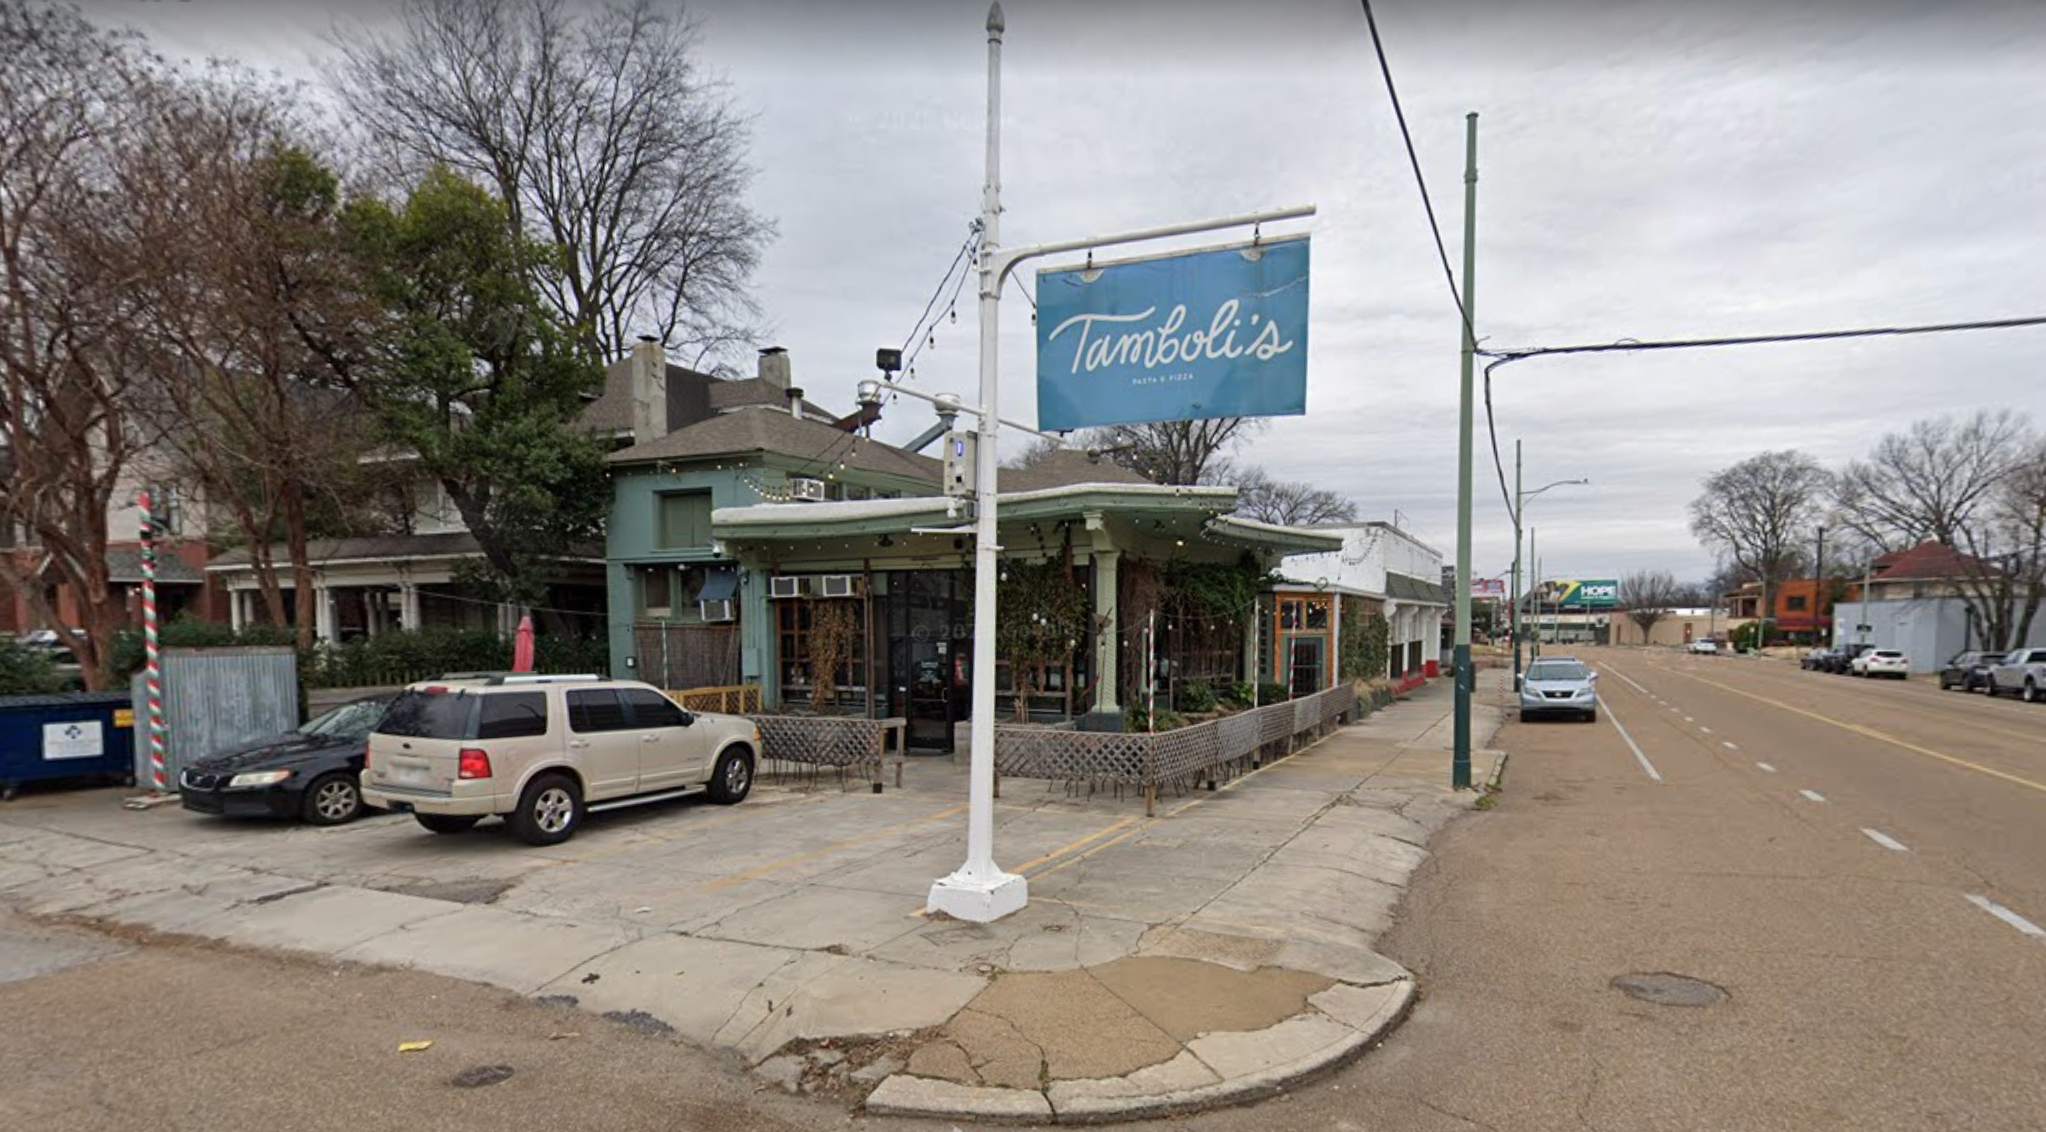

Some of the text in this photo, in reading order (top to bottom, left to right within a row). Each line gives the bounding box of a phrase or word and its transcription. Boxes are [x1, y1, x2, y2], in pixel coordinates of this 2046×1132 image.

[1048, 298, 1293, 374] Tamboli's
[1132, 376, 1157, 385] PASTA
[1169, 373, 1194, 381] PIZZA
[1581, 586, 1616, 597] HOPE
